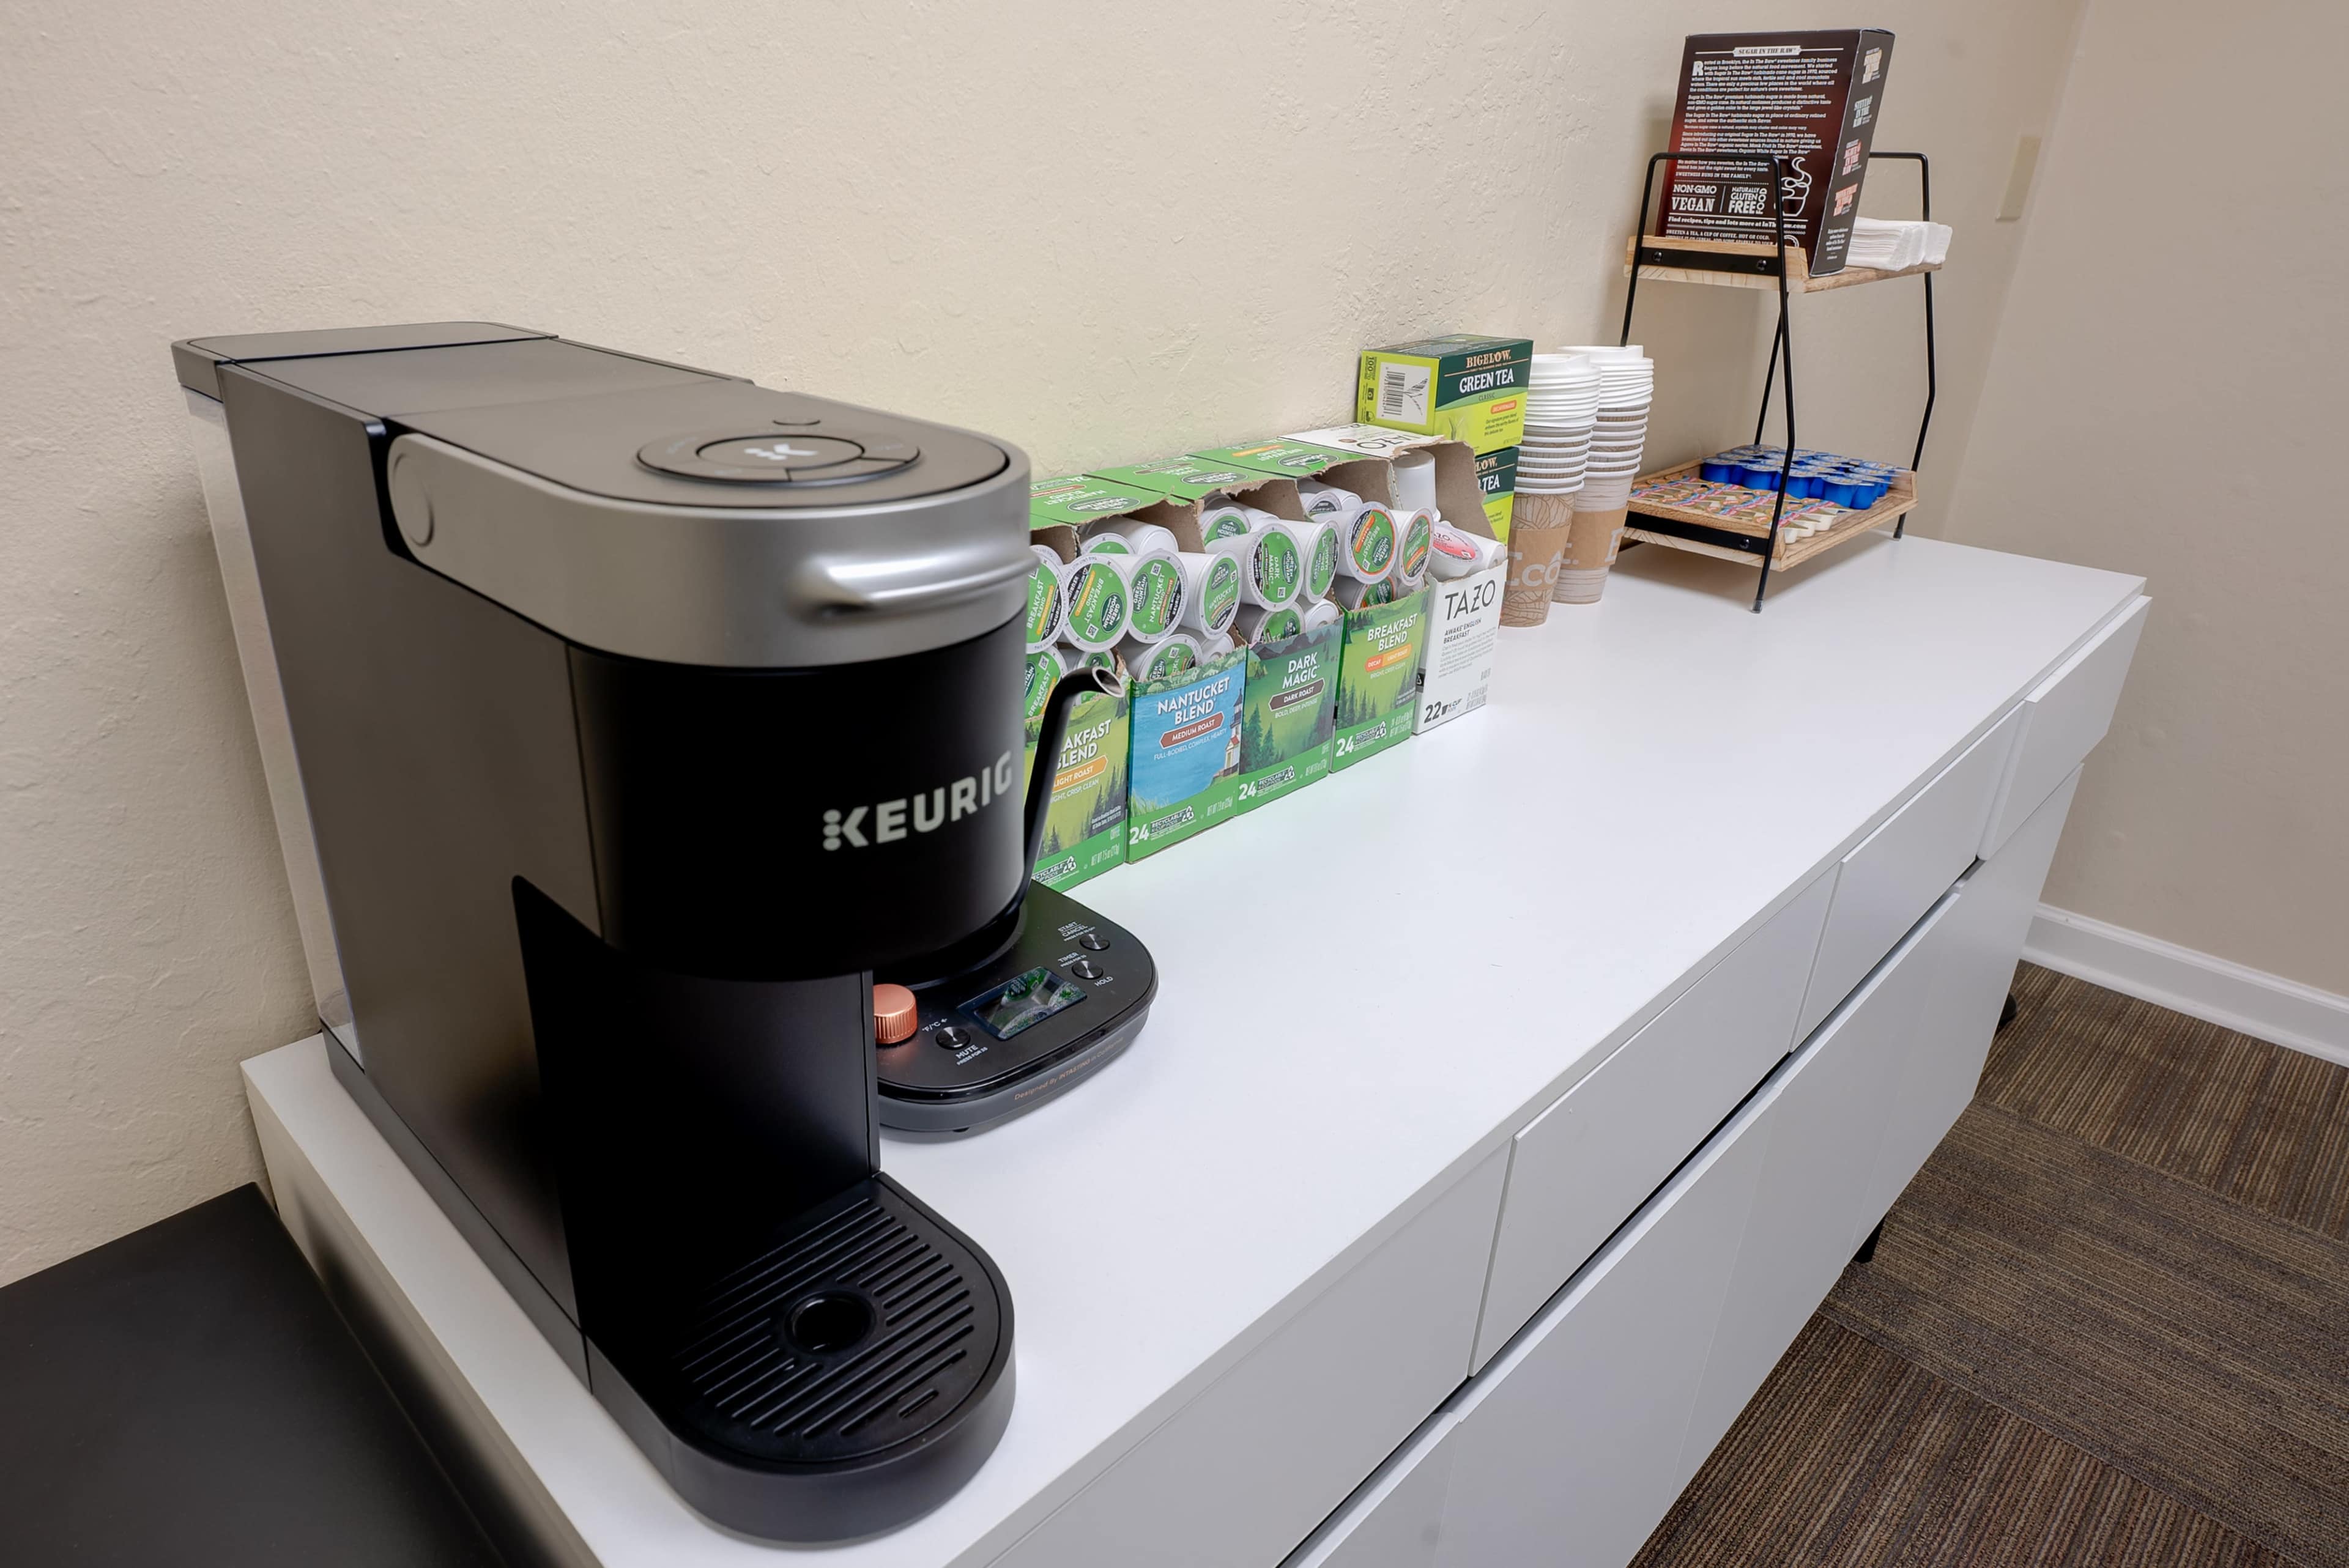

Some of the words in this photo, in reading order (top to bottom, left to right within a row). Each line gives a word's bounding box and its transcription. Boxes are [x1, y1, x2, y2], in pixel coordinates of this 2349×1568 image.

[1673, 184, 1717, 194] NON-GMO
[1731, 192, 1757, 201] GLUTEN
[1672, 197, 1715, 212] VEGAN
[1728, 200, 1756, 214] FREE
[1756, 188, 1767, 215] FOOD
[1459, 372, 1494, 394] GREEN
[1495, 368, 1514, 386] TEA
[1479, 392, 1496, 402] CLASSIC
[1482, 474, 1501, 492] TEA
[1222, 523, 1238, 532] GREEN
[1363, 525, 1381, 558] BREAKFAST
[1374, 537, 1389, 563] MOUNTAIN
[1379, 544, 1389, 562] GREEN
[1084, 578, 1104, 624] BREAKFAST
[1086, 587, 1097, 607] BLEND
[1137, 576, 1147, 610] MOUNTAIN
[1149, 573, 1165, 623] NANTUCKET
[1445, 579, 1496, 621] TAZO
[1026, 580, 1044, 629] BREAKFAST
[1103, 594, 1118, 629] MOUNTAIN
[1109, 604, 1121, 626] GREEN
[1367, 613, 1418, 642] BREAKFAST
[1444, 625, 1464, 637] AWAKE
[1464, 617, 1482, 630] ENGLISH
[1444, 630, 1470, 644] BREAKFAST
[1378, 631, 1408, 652] BLEND
[1288, 651, 1318, 673] DARK
[1368, 659, 1381, 668] DECAF
[1282, 665, 1320, 689] MAGIC
[1028, 670, 1051, 717] BREAKFAST
[1157, 677, 1230, 715] NANTUCKET
[1284, 692, 1299, 703] DARK
[1299, 686, 1315, 697] ROAST
[1174, 699, 1215, 725] BLEND
[1424, 701, 1442, 724] 22
[1060, 719, 1112, 753] AKFAST
[1172, 728, 1197, 742] MEDIUM
[1198, 719, 1215, 731] ROAST
[1154, 746, 1187, 760] FULL-BODIED,
[1335, 735, 1354, 758] 24
[1053, 775, 1072, 788] LIGHT
[1074, 766, 1094, 780] ROAST
[1066, 786, 1082, 797] CRISP,
[1083, 779, 1099, 790] CLEAN
[1238, 781, 1257, 801] 24
[823, 750, 1013, 851] KEURIG
[1152, 812, 1184, 827] RECYCLABLE
[1129, 824, 1150, 845] 24
[1058, 921, 1077, 932] START
[1062, 925, 1088, 937] CANCEL
[1058, 952, 1079, 963] TIMER
[1094, 976, 1114, 987] HOLD
[956, 1044, 979, 1059] MUTE
[957, 1056, 973, 1065] PRESS
[1014, 1081, 1048, 1101] Designed
[1049, 1077, 1058, 1086] By
